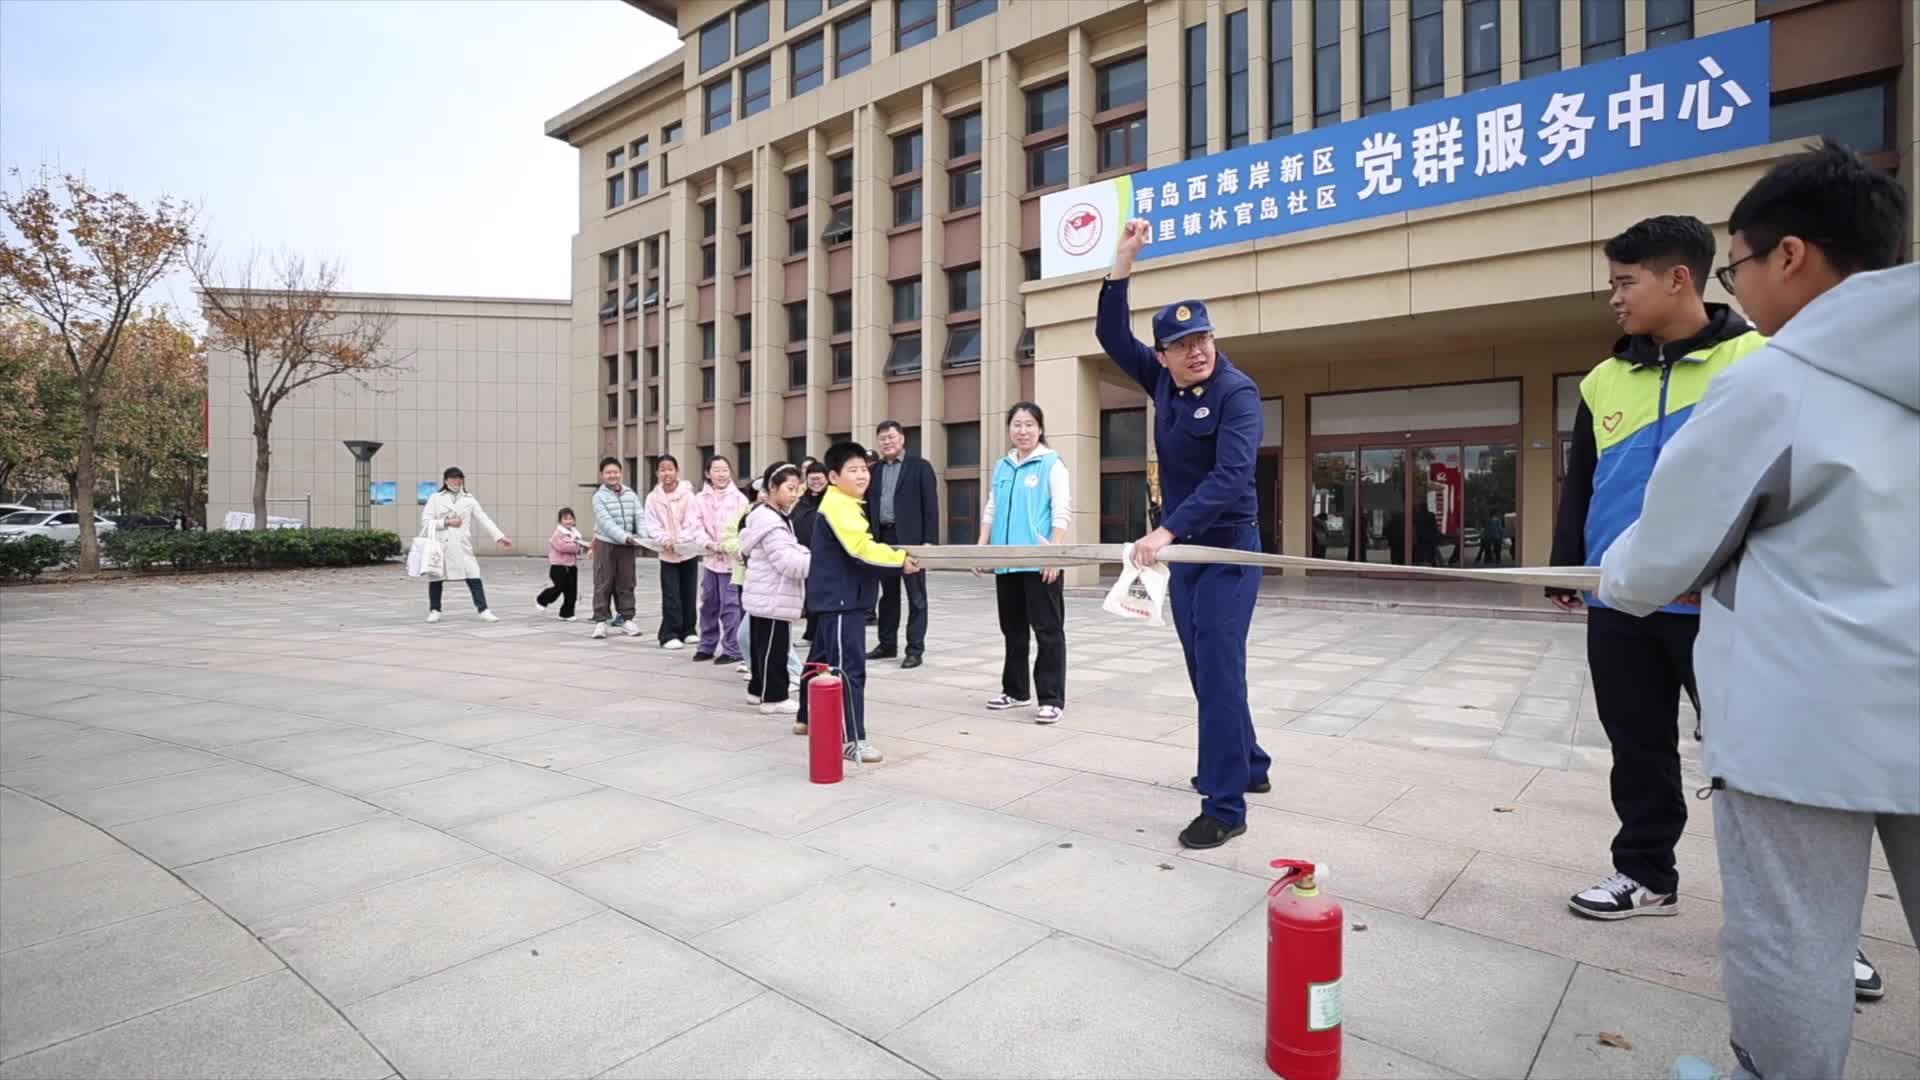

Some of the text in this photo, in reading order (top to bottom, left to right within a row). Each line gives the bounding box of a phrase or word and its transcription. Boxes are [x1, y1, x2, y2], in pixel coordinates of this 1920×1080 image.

[1356, 56, 1752, 200] 党群服务中心
[1135, 146, 1335, 214] 青岛西海岸新区
[1142, 184, 1337, 244] 里镇沐官岛社区
